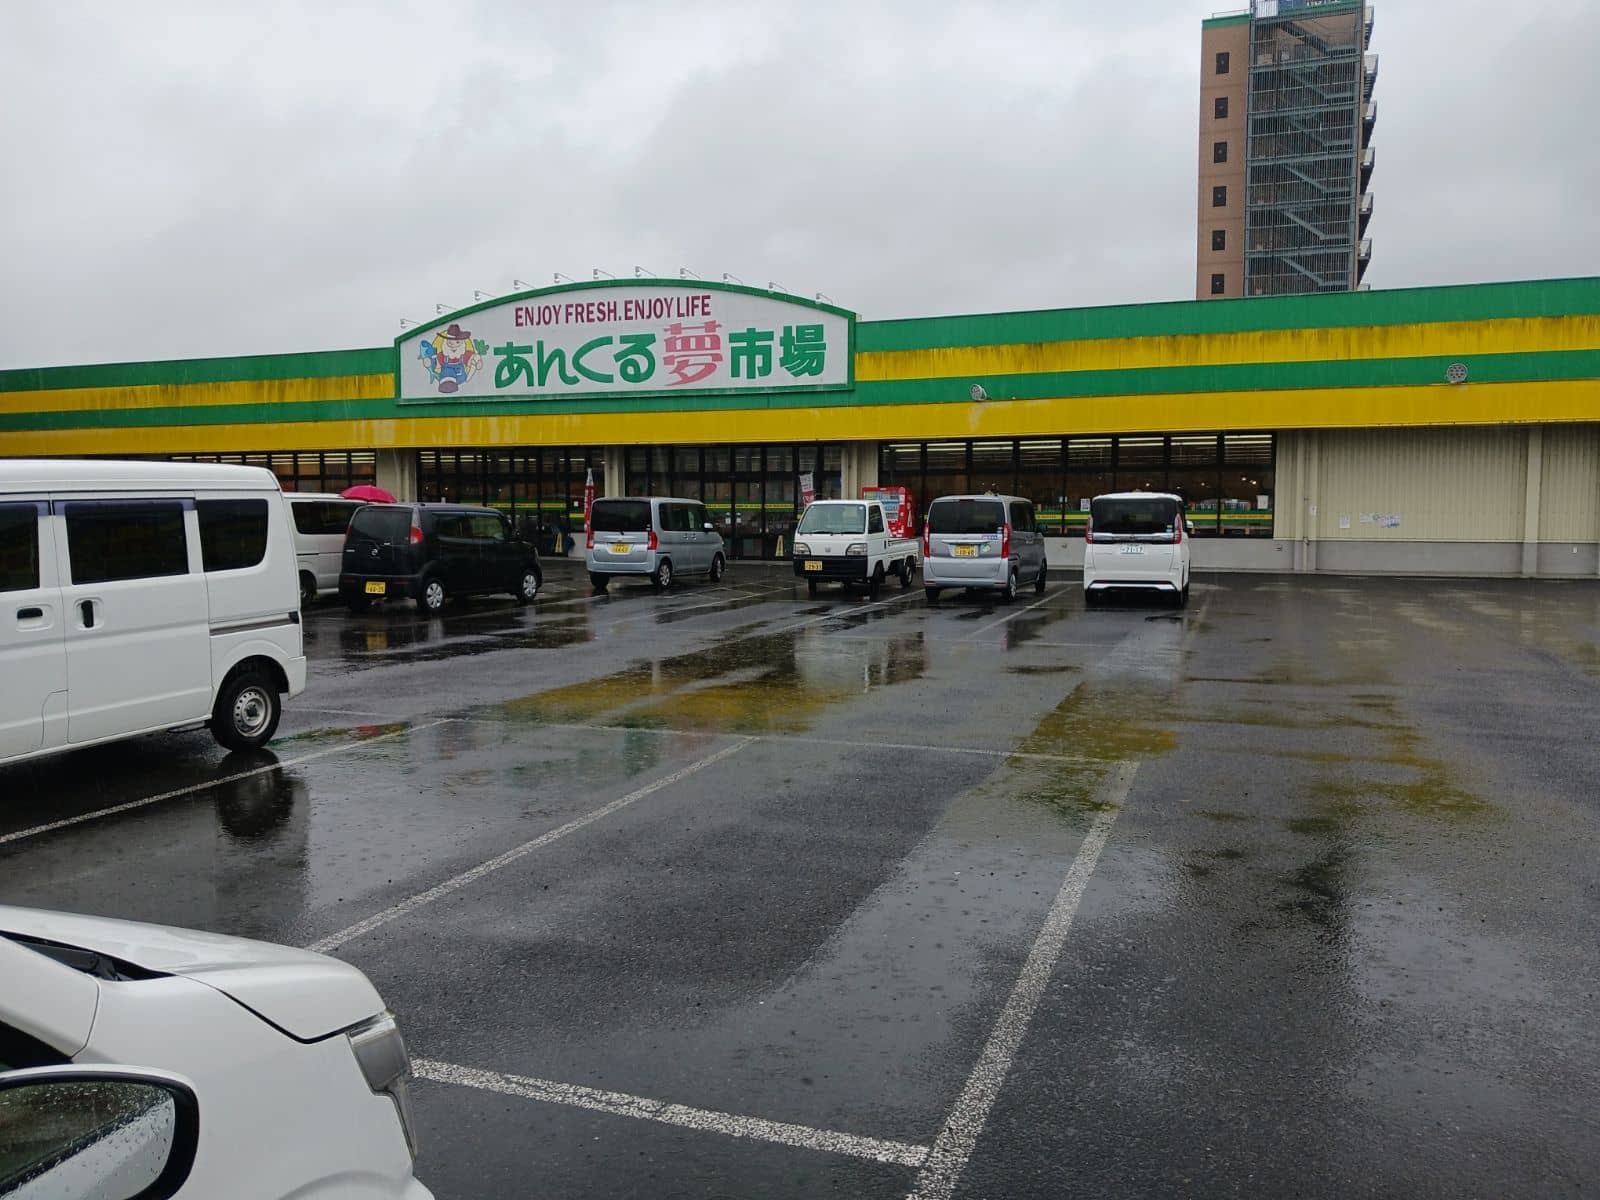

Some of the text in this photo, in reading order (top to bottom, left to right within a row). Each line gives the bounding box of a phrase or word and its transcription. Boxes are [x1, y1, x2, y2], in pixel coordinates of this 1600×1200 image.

[514, 304, 562, 327] ENJOY
[676, 295, 711, 318] LIFE
[494, 320, 827, 389] あんくる夢市場
